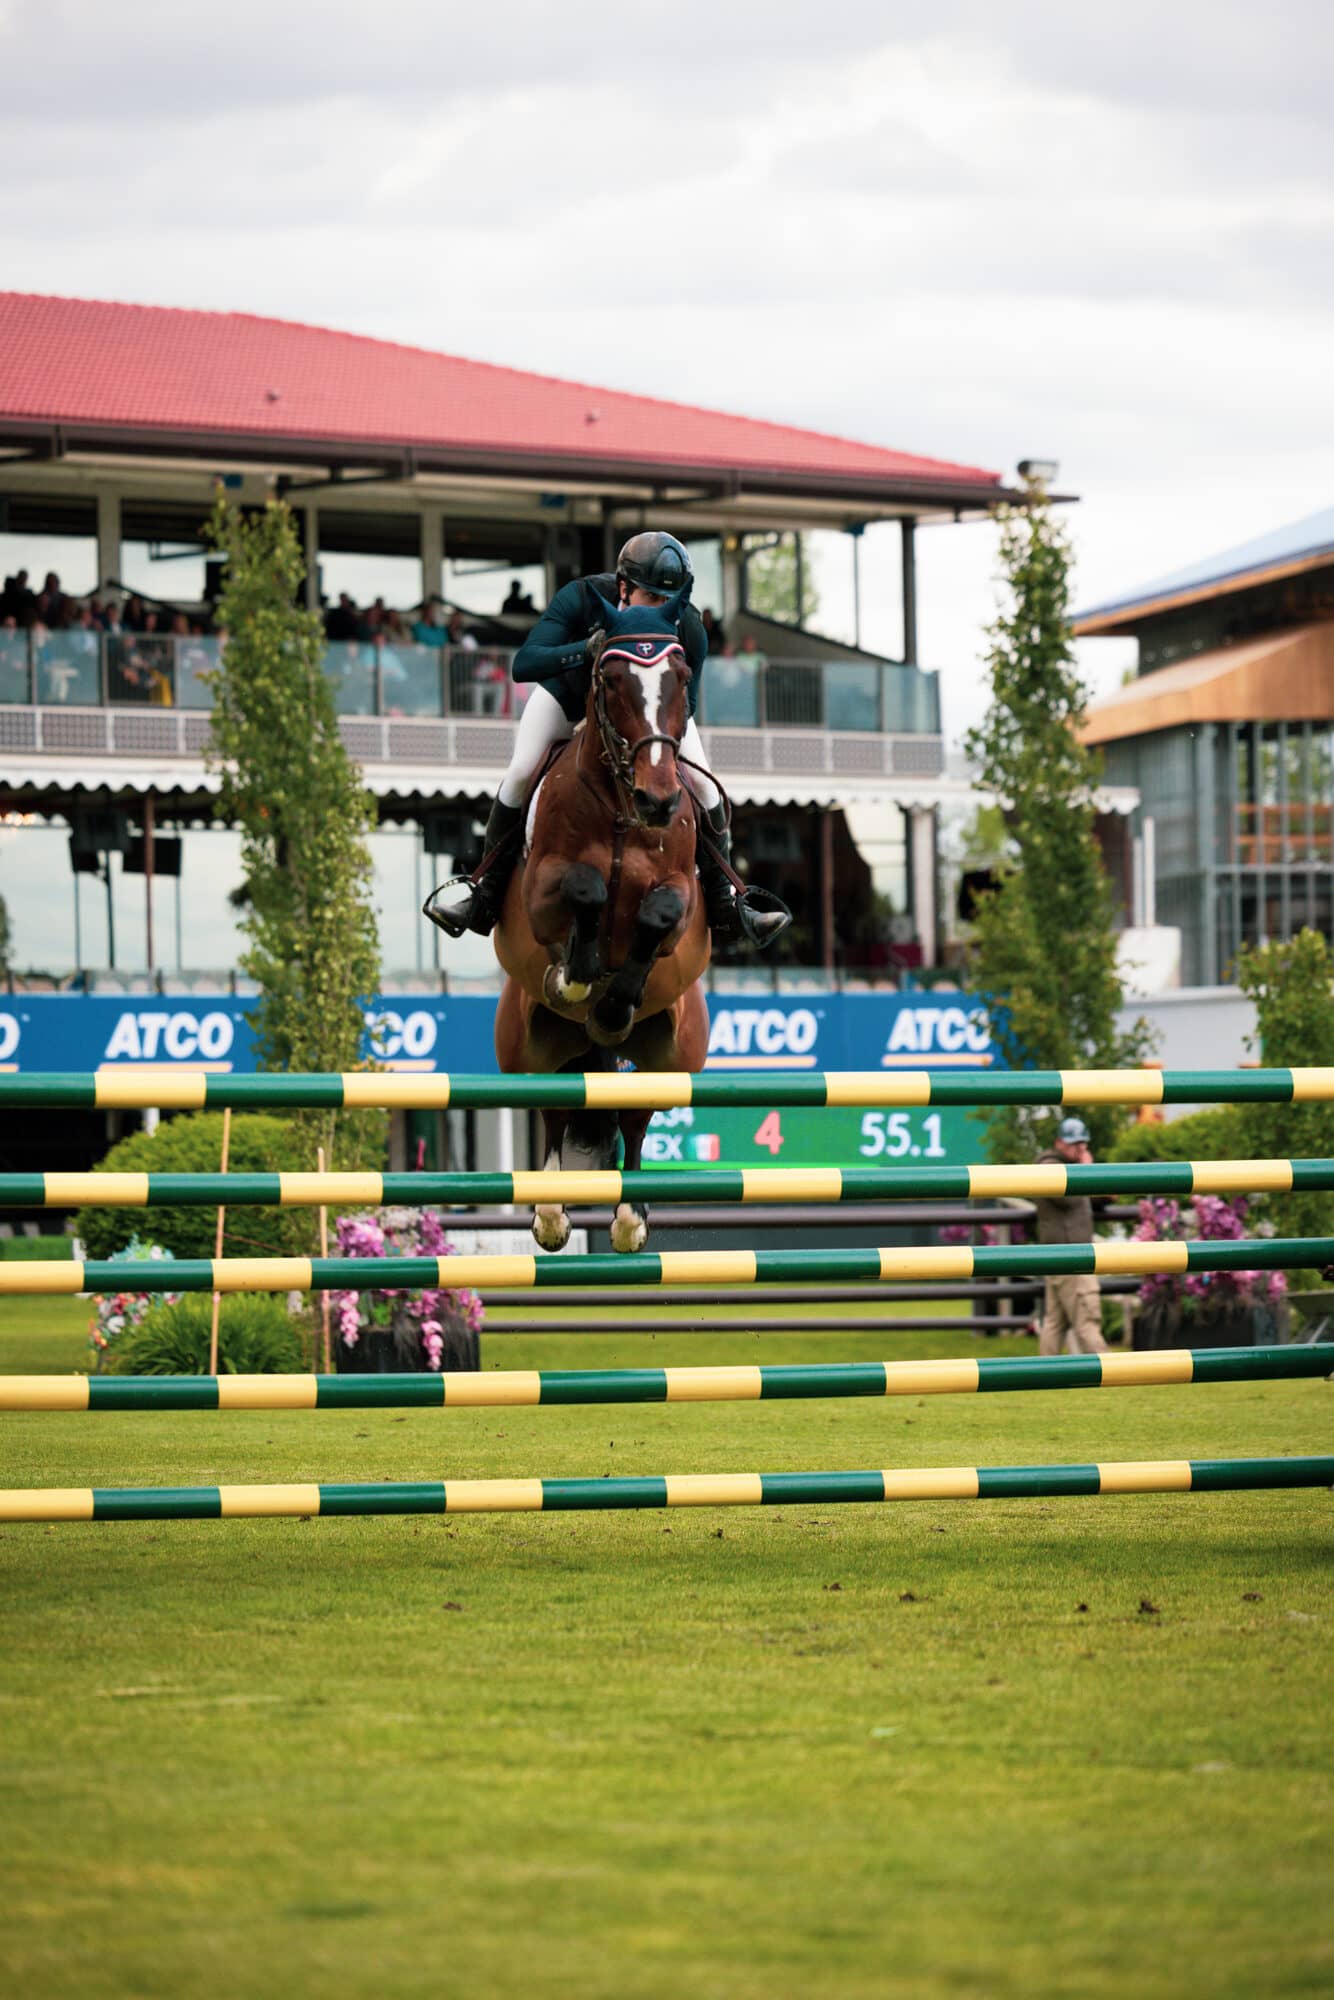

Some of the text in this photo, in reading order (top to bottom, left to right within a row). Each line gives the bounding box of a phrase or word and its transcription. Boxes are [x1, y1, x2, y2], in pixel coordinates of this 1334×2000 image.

[105, 1012, 234, 1059] ATCO
[364, 1011, 437, 1058] CO
[707, 1009, 818, 1054] ATCO
[887, 1008, 991, 1052] ATCO
[754, 1111, 784, 1155] 4
[860, 1113, 945, 1157] 55.1
